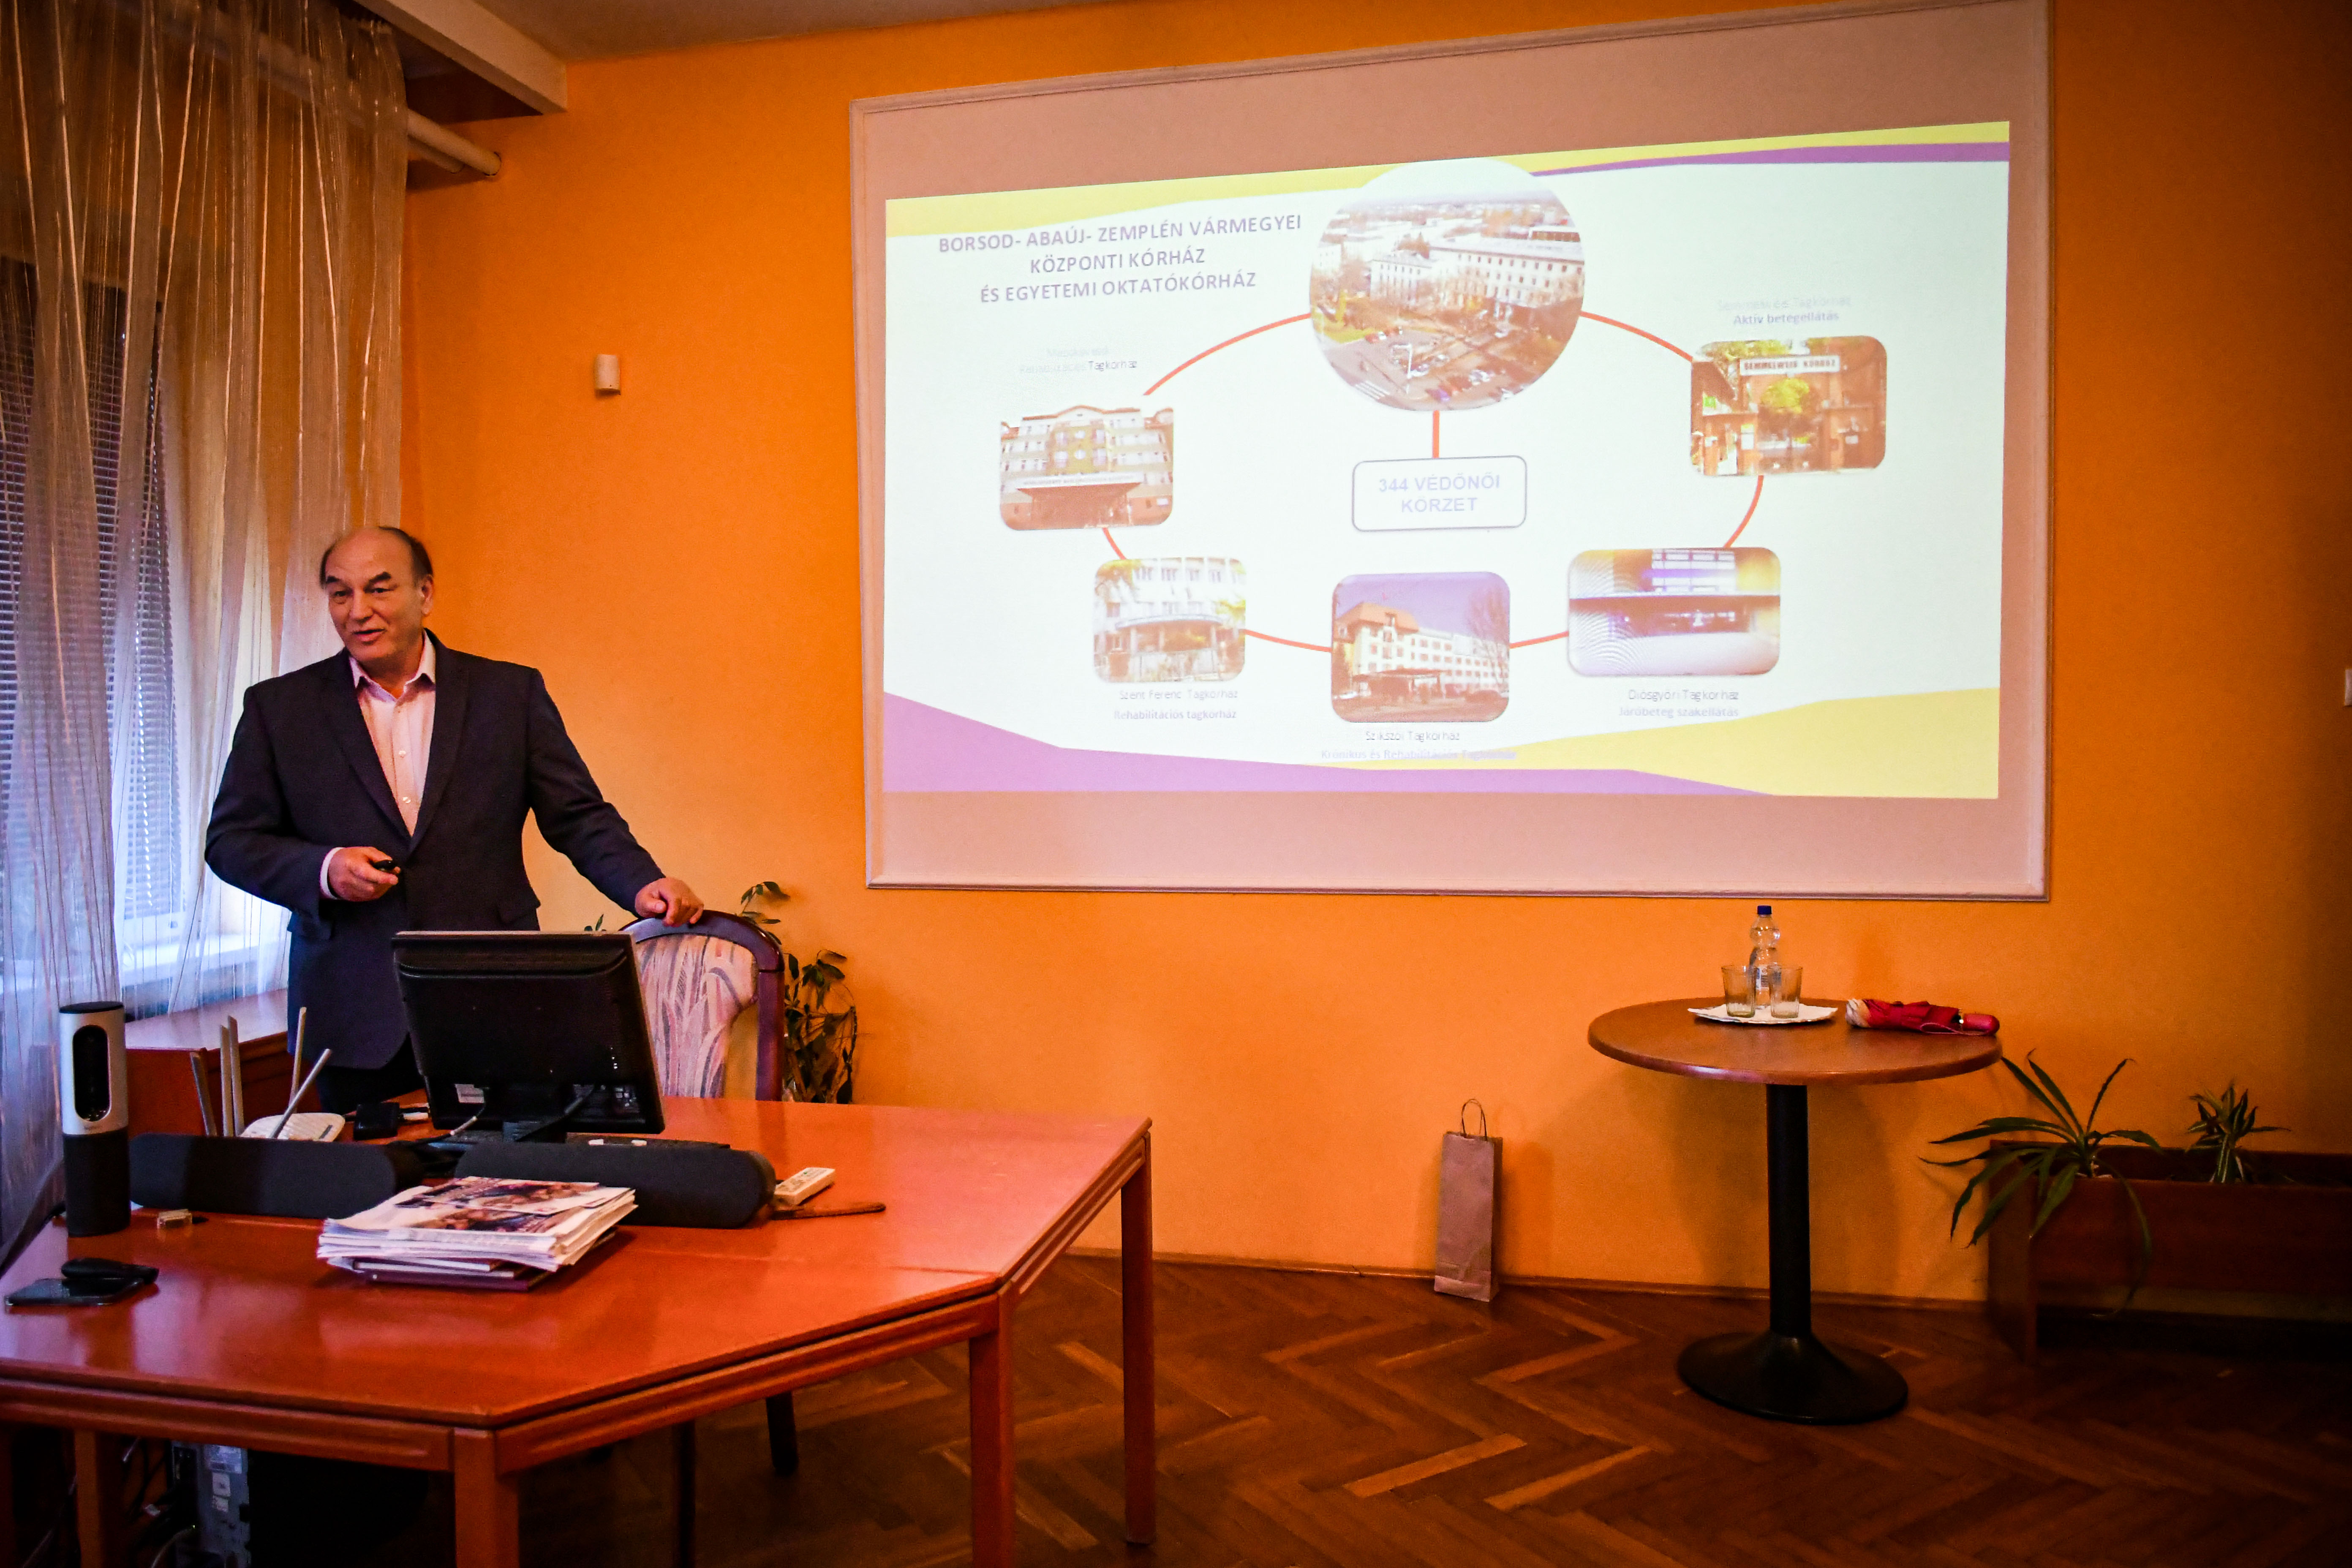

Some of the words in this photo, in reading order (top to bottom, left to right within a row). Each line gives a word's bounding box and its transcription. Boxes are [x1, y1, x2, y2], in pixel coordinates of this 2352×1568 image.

[939, 237, 1021, 253] BORSOD-
[1025, 227, 1092, 247] ABAÚJ-
[1098, 220, 1182, 242] ZEMPLÉN
[1190, 215, 1301, 236] VÁRMEGYEI
[1031, 254, 1122, 273] KÖZPONTI
[1129, 247, 1205, 267] KÓRHÁZ
[981, 285, 999, 303] ÉS
[1006, 282, 1096, 301] EGYETEMI
[1102, 272, 1255, 295] OKTATÓKÓRHÁZ
[1379, 478, 1409, 493] 344
[1414, 472, 1500, 490] VÉDŐNŐI
[1402, 496, 1478, 512] KÖRZET
[1120, 691, 1145, 700] Szent
[1149, 690, 1181, 699] Ferenc
